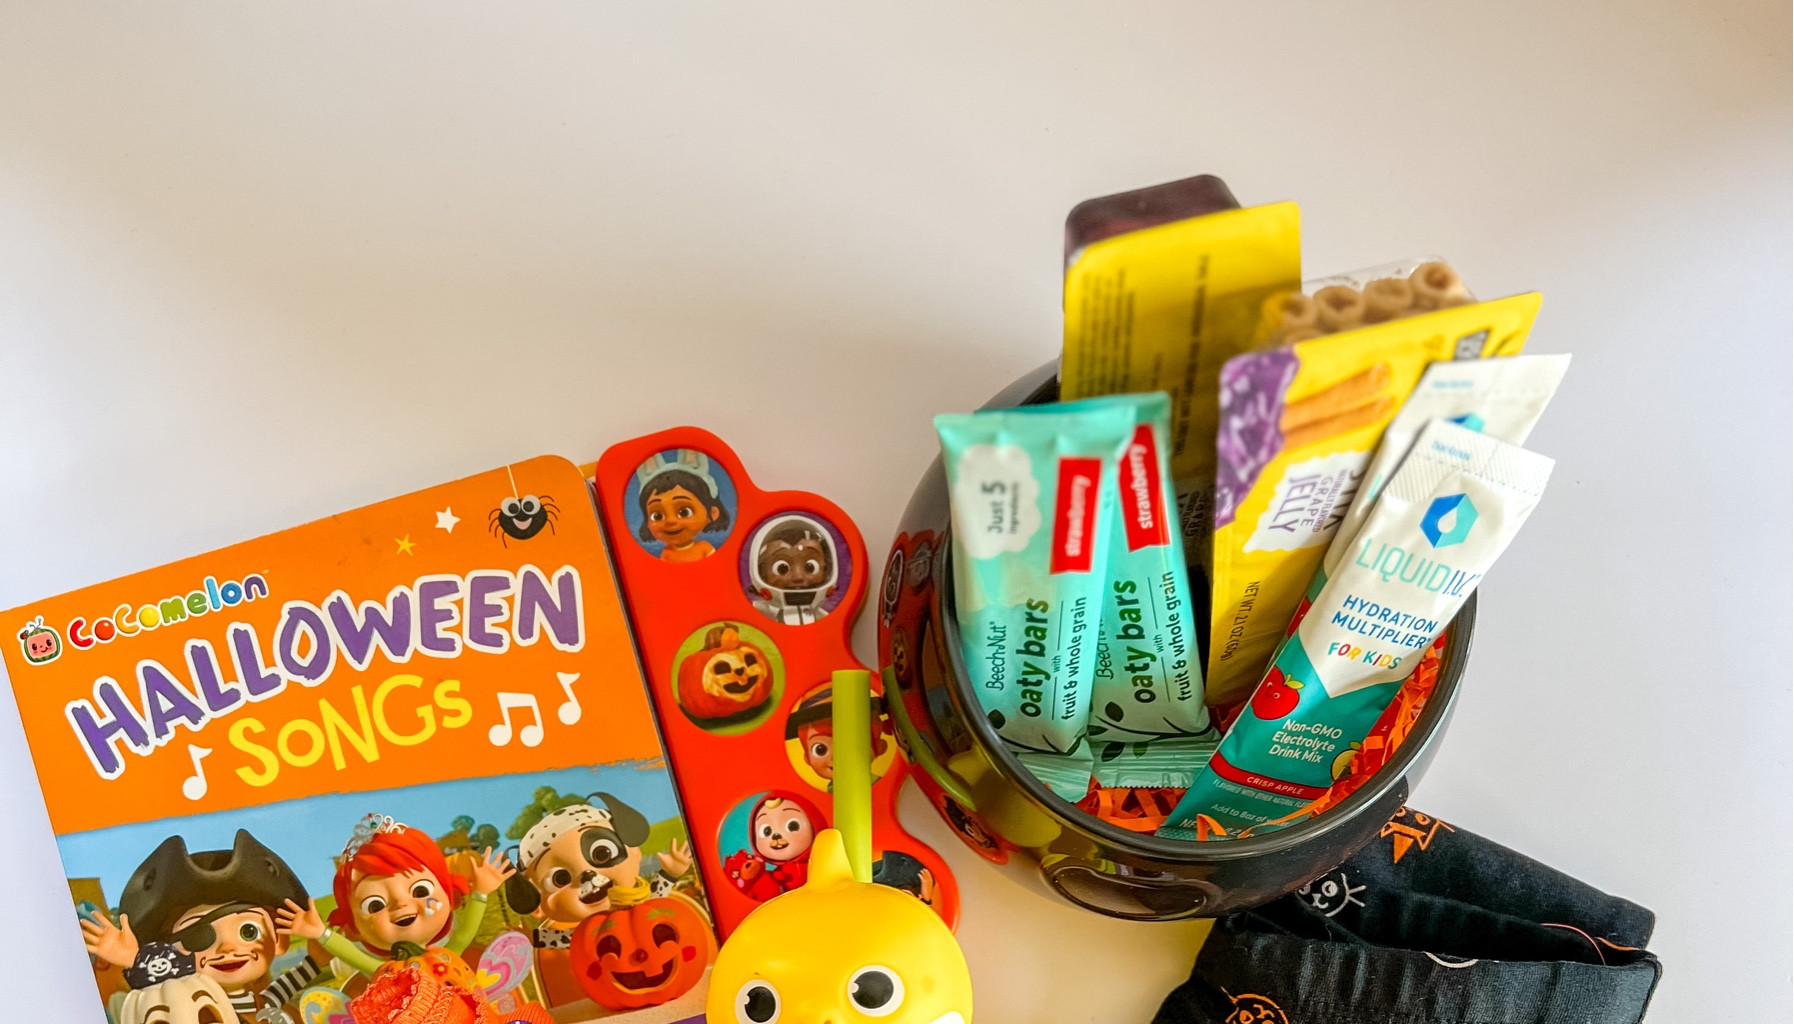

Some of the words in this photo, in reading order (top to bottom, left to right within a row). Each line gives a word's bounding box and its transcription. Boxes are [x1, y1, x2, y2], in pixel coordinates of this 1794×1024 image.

[981, 480, 1006, 495] 5
[1128, 444, 1154, 529] strawberry
[1268, 474, 1321, 533] JELLY
[1301, 476, 1334, 526] GRAPE
[987, 499, 1004, 534] Just
[1065, 475, 1091, 557] strawberry
[1356, 538, 1451, 593] LIQUID
[1160, 571, 1181, 611] grain
[1244, 581, 1260, 598] NET
[1016, 598, 1049, 658] bars
[1073, 597, 1087, 637] grain
[1113, 580, 1145, 640] bars
[1342, 595, 1439, 634] HYDRATION
[1153, 634, 1165, 653] with
[1168, 613, 1184, 660] whole
[66, 565, 586, 780] HALLOWEEN
[1052, 655, 1062, 673] with
[1065, 638, 1081, 680] whole
[1124, 646, 1157, 703] oaty
[1174, 660, 1187, 672] &
[1328, 642, 1362, 660] FOR
[1363, 650, 1402, 670] KIDS
[1019, 662, 1051, 718] oaty
[1063, 679, 1078, 692] &
[1175, 670, 1192, 702] fruit
[1061, 692, 1077, 720] fruit
[1271, 731, 1336, 753] Electrolyte
[1282, 718, 1343, 739] Non-GMO
[1268, 744, 1300, 760] Drink
[1302, 751, 1323, 764] Mix
[1246, 776, 1275, 788] CRISP
[1275, 783, 1304, 795] APPLE
[1210, 803, 1229, 814] Add
